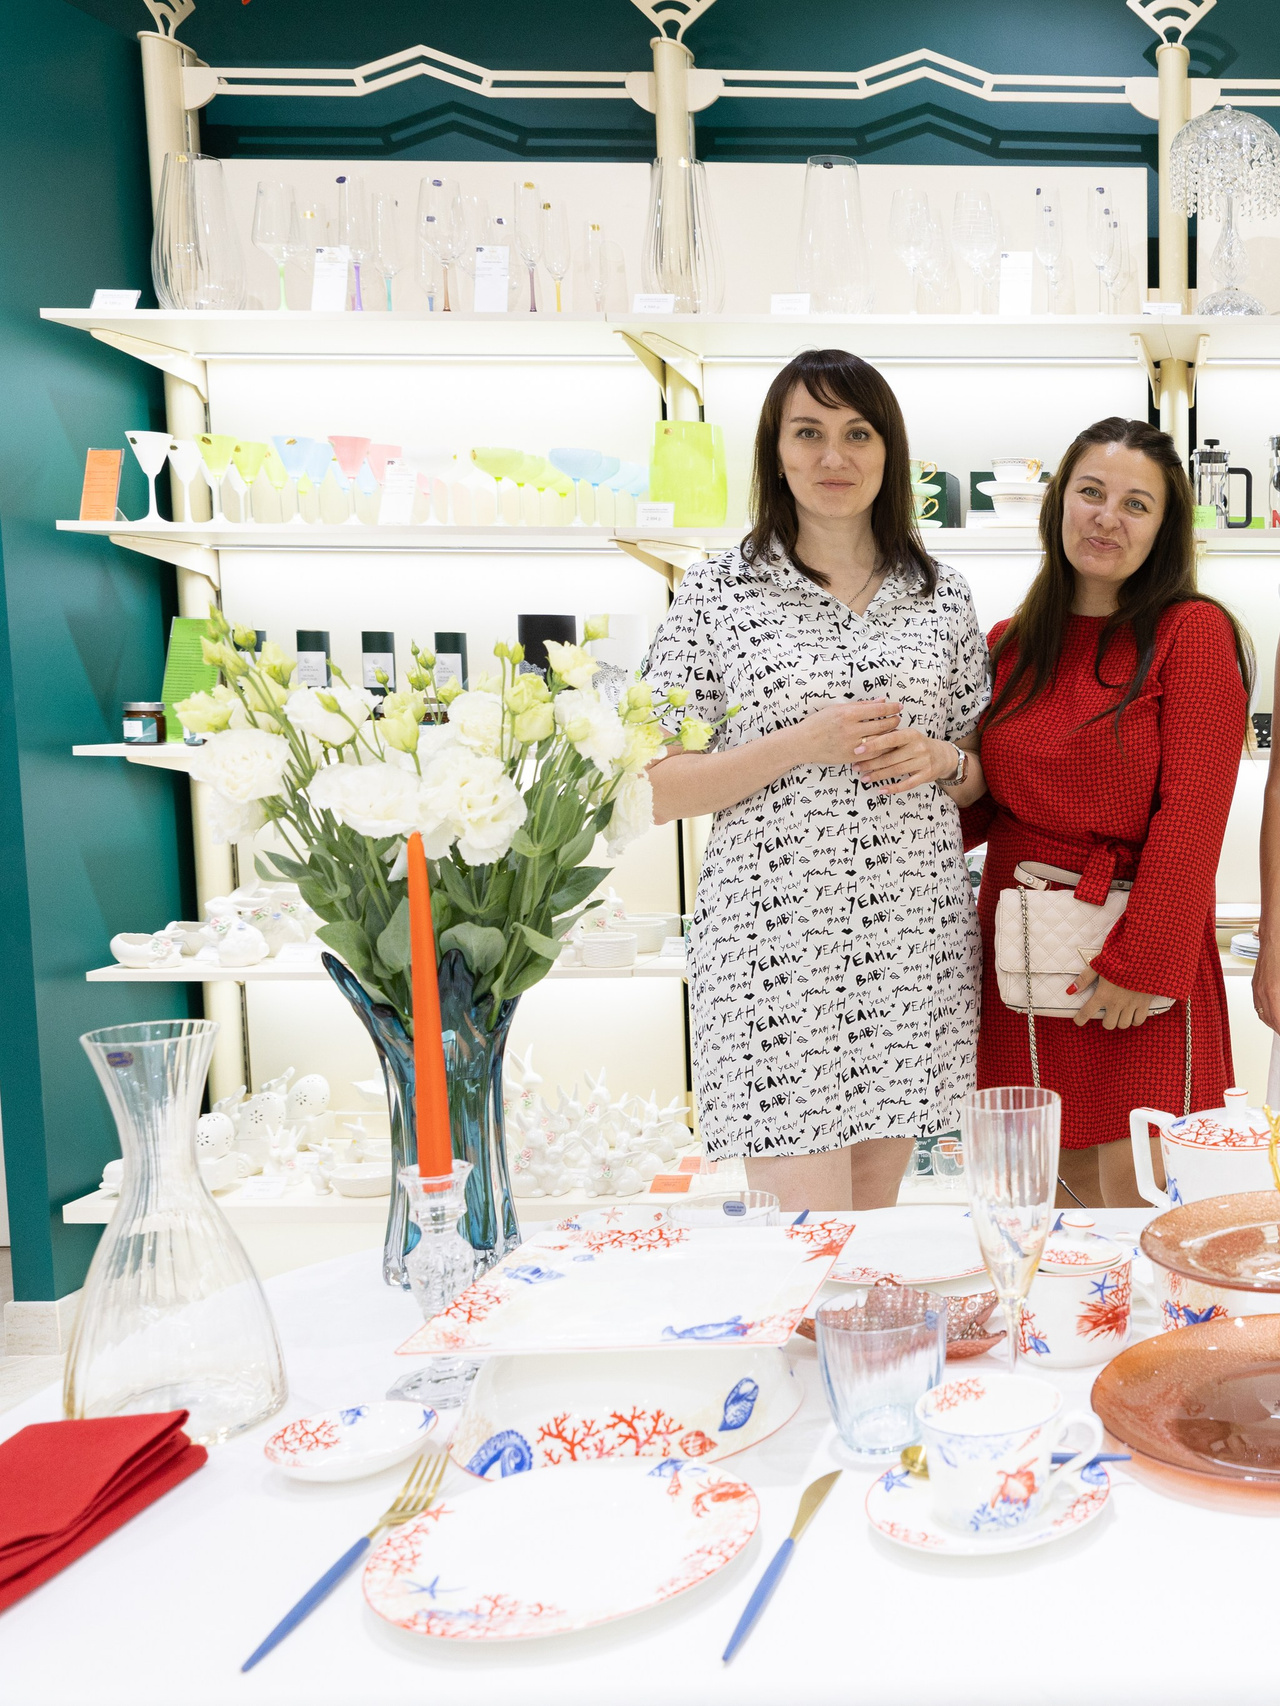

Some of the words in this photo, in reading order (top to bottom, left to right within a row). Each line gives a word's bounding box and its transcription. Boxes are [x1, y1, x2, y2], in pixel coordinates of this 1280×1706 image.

[734, 588, 764, 602] BABY
[733, 605, 755, 614] BABY
[777, 601, 812, 611] yeah
[892, 605, 920, 614] yeah
[793, 611, 838, 624] YEAH
[901, 616, 939, 627] YEAH
[676, 626, 696, 636] BABY
[750, 630, 780, 647] BABY
[794, 642, 829, 651] yeah
[897, 645, 926, 653] yeah
[660, 650, 697, 665] YEAH
[809, 653, 853, 665] YEAH
[910, 657, 942, 670] YEAH
[728, 660, 752, 693] YEAH
[809, 670, 834, 679] BABY
[763, 674, 790, 698] BABY
[827, 680, 851, 689] BABY
[863, 674, 892, 692] BABY
[909, 677, 929, 686] BABY
[696, 689, 725, 701] BABY
[801, 690, 836, 704] yeah
[899, 696, 926, 704] yeah
[688, 704, 709, 713] BABY
[737, 711, 764, 737] YEAH
[815, 788, 838, 797] BABY
[736, 796, 754, 808] BABY
[745, 803, 763, 814] BABY
[773, 791, 796, 813] BABY
[832, 798, 855, 807] BABY
[867, 793, 891, 811] BABY
[804, 808, 839, 823] yeah
[900, 812, 924, 824] yeah
[725, 818, 748, 833] yeah
[815, 822, 859, 841] YEAH
[730, 827, 765, 850] YEAH
[910, 826, 936, 843] YEAH
[813, 847, 836, 856] BABY
[726, 854, 744, 866] BABY
[769, 850, 795, 873] BABY
[829, 857, 853, 866] BABY
[865, 851, 892, 869] BABY
[941, 856, 957, 869] BABY
[738, 862, 758, 873] BABY
[803, 867, 837, 882] yeah
[900, 869, 925, 882] yeah
[719, 875, 744, 891] yeah
[725, 885, 761, 909] YEAH
[814, 881, 857, 900] YEAH
[909, 883, 938, 900] YEAH
[812, 906, 833, 917] BABY
[722, 913, 740, 925] BABY
[766, 911, 793, 932] BABY
[827, 916, 850, 925] BABY
[862, 909, 891, 928] BABY
[941, 912, 959, 928] BABY
[734, 921, 755, 932] BABY
[802, 927, 834, 942] yeah
[855, 932, 877, 942] BABY
[898, 927, 924, 940] yeah
[713, 934, 740, 950] yeah
[908, 939, 936, 958] YEAH
[720, 944, 758, 968] YEAH
[814, 939, 853, 960] YEAH
[811, 964, 830, 976] BABY
[903, 964, 922, 974] BABY
[937, 967, 955, 984] BABY
[717, 972, 736, 983] BABY
[763, 970, 792, 992] BABY
[825, 974, 844, 984] BABY
[856, 967, 886, 986] BABY
[730, 981, 751, 992] BABY
[892, 984, 922, 998] yeah
[958, 984, 976, 996] yeah
[758, 995, 779, 1006] BABY
[801, 986, 829, 1002] yeah
[848, 991, 871, 999] BABY
[711, 994, 737, 1010] yeah
[902, 996, 934, 1016] YEAH
[721, 1004, 755, 1027] YEAH
[813, 998, 846, 1020] YEAH
[811, 1025, 829, 1036] BABY
[897, 1021, 919, 1031] BABY
[935, 1022, 949, 1040] BABY
[848, 1024, 878, 1044] BABY
[731, 1041, 750, 1050] BABY
[761, 1031, 792, 1052] BABY
[885, 1041, 918, 1054] yeah
[953, 1039, 973, 1051] yeah
[717, 1053, 736, 1069] yeah
[756, 1056, 778, 1066] BABY
[801, 1046, 829, 1063] yeah
[812, 1057, 841, 1080] YEAH
[895, 1053, 932, 1072] YEAH
[889, 1078, 913, 1087] BABY
[810, 1084, 830, 1097] BABY
[845, 1081, 871, 1102] BABY
[905, 1087, 927, 1095] BABY
[760, 1091, 790, 1113] BABY
[877, 1097, 911, 1110] yeah
[800, 1106, 831, 1123] yeah
[888, 1109, 928, 1128] YEAH
[754, 1116, 777, 1127] BABY
[812, 1115, 842, 1141] YEAH
[809, 1144, 830, 1154] BABY
